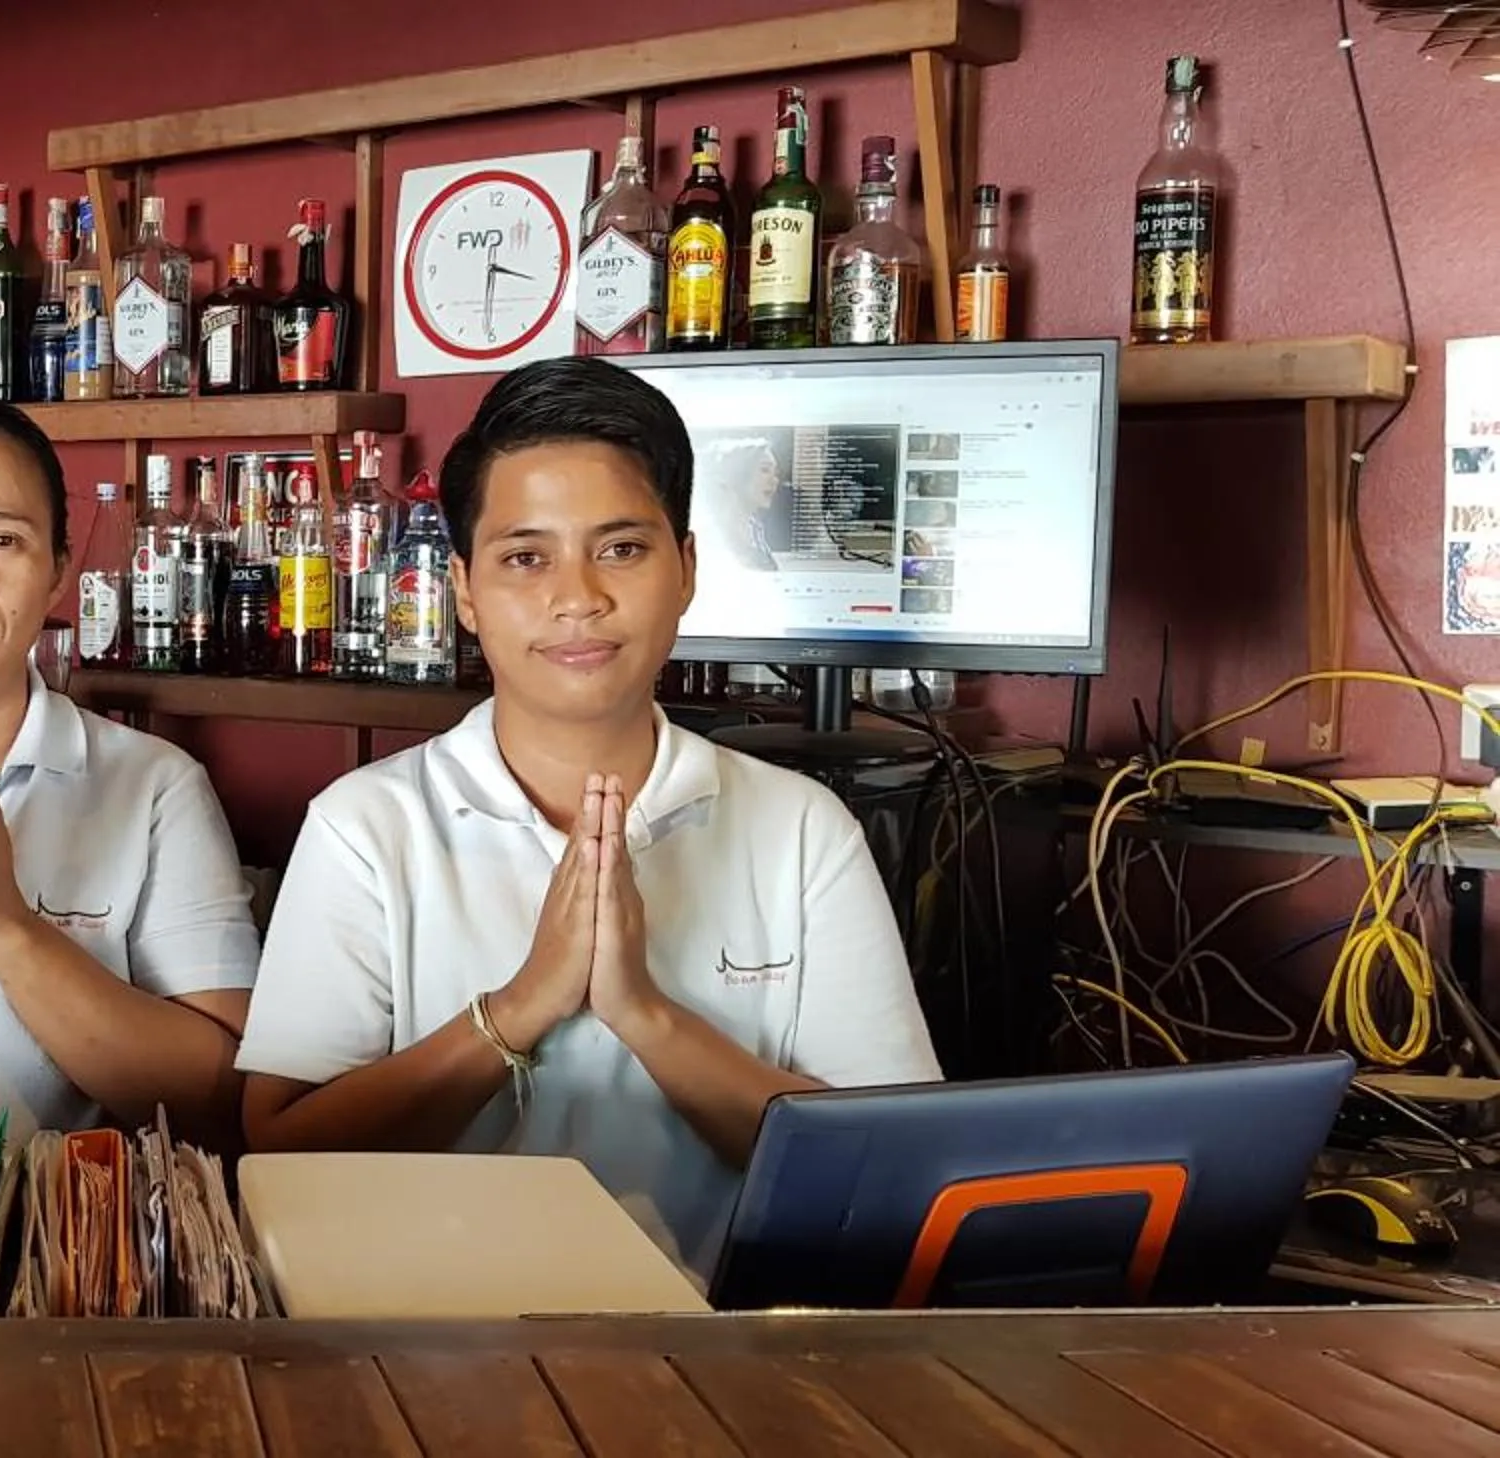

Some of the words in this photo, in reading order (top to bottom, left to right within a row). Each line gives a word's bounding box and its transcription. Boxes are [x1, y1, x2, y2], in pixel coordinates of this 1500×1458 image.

[489, 191, 505, 207] 12
[1152, 216, 1206, 233] PIPERS
[428, 265, 437, 280] 9
